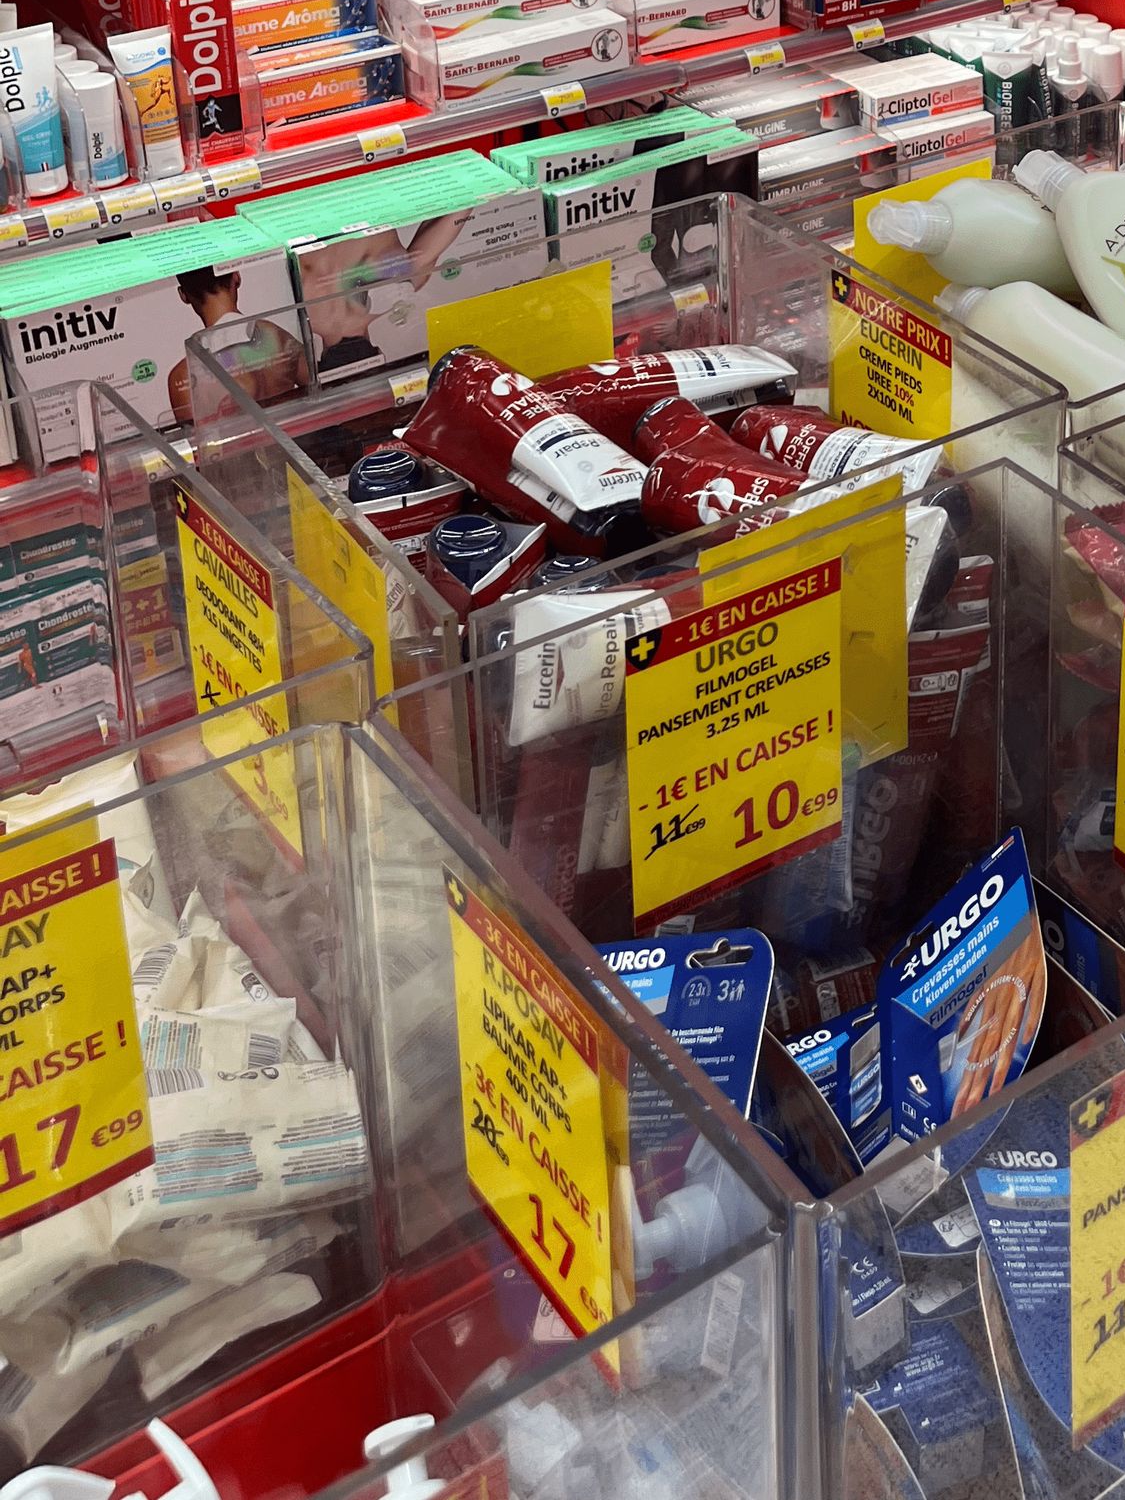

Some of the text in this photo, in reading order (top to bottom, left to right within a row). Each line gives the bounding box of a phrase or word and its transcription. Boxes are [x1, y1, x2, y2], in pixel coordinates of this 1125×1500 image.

[282, 3, 340, 29] Arôma
[309, 76, 367, 99] Arôma
[445, 54, 522, 80] SAINT-BERNARD
[565, 187, 638, 222] initiv
[19, 303, 118, 353] initiv
[25, 332, 125, 364] Biologie Augmentée
[855, 289, 940, 355] NOTRE PRIX
[861, 319, 922, 371] EUCERIN
[860, 346, 922, 394] CREME PIEDS
[867, 367, 914, 406] UREE 10%
[868, 384, 914, 424] 2X100 ML
[193, 537, 259, 618] CAVAILLES
[689, 575, 818, 642] 1€ EN CAISSE
[695, 621, 778, 673] URGO
[638, 652, 831, 745] PANSEMENT CREVASSES
[696, 654, 778, 698] FILMOGEL
[706, 701, 770, 737] 3.25 ML
[656, 718, 820, 809] 1€ EN CAISSE
[922, 873, 1005, 964] URGO
[608, 948, 664, 970] URGO
[911, 915, 1002, 1004] Crevasses mains
[482, 946, 566, 1061] R.POSAY
[483, 987, 568, 1100] LIPIKAR AP+
[482, 1018, 572, 1133] BAUME CORPS
[505, 1069, 550, 1131] 400 ML
[476, 1067, 591, 1225] 3€ EN CAISSE
[1000, 1150, 1057, 1168] URGO
